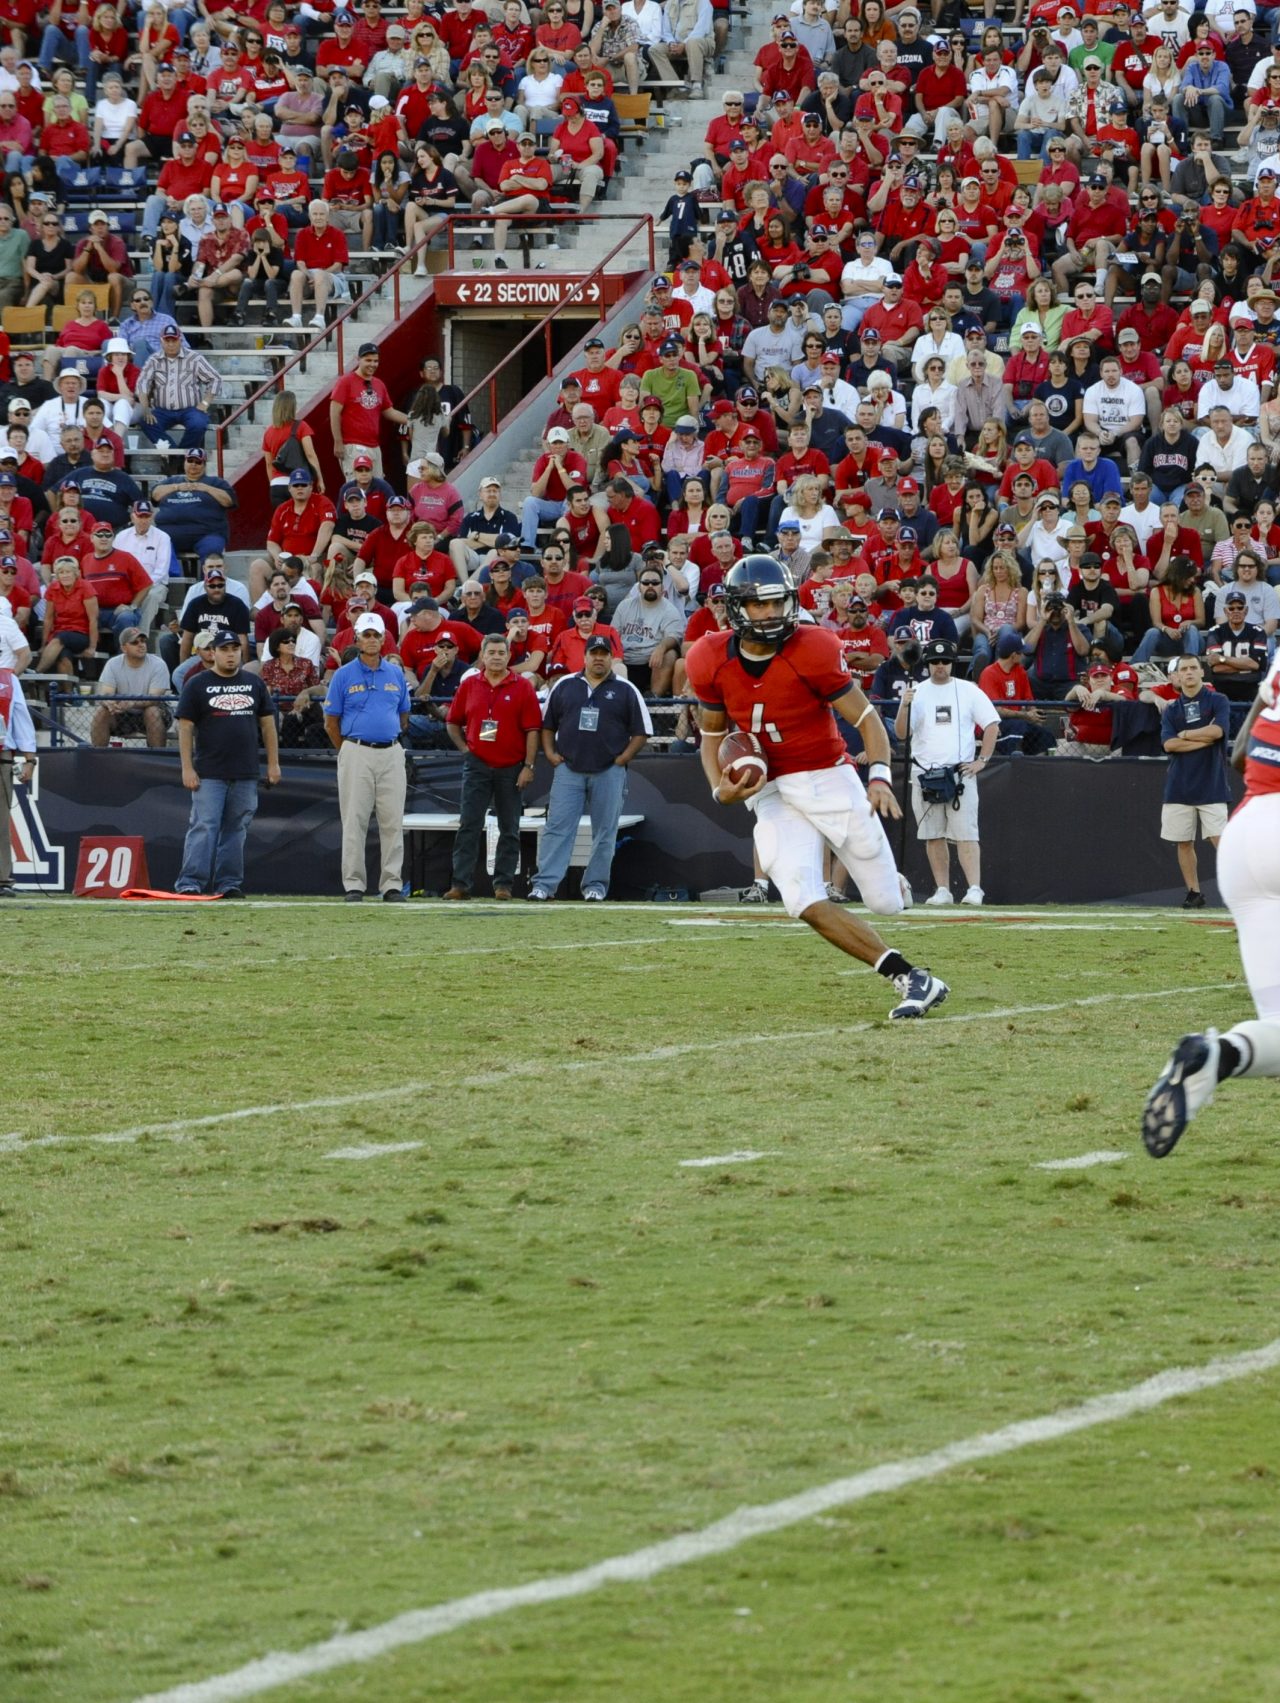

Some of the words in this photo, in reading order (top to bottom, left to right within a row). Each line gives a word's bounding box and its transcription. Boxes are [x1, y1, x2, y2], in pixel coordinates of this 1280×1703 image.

[896, 54, 923, 64] RIZONA
[677, 202, 686, 219] 7
[475, 283, 492, 302] 22
[498, 283, 555, 302] SECTION
[198, 614, 230, 626] ARIZONA
[206, 686, 222, 694] CAT
[223, 685, 253, 693] VISION
[86, 847, 132, 889] 20
